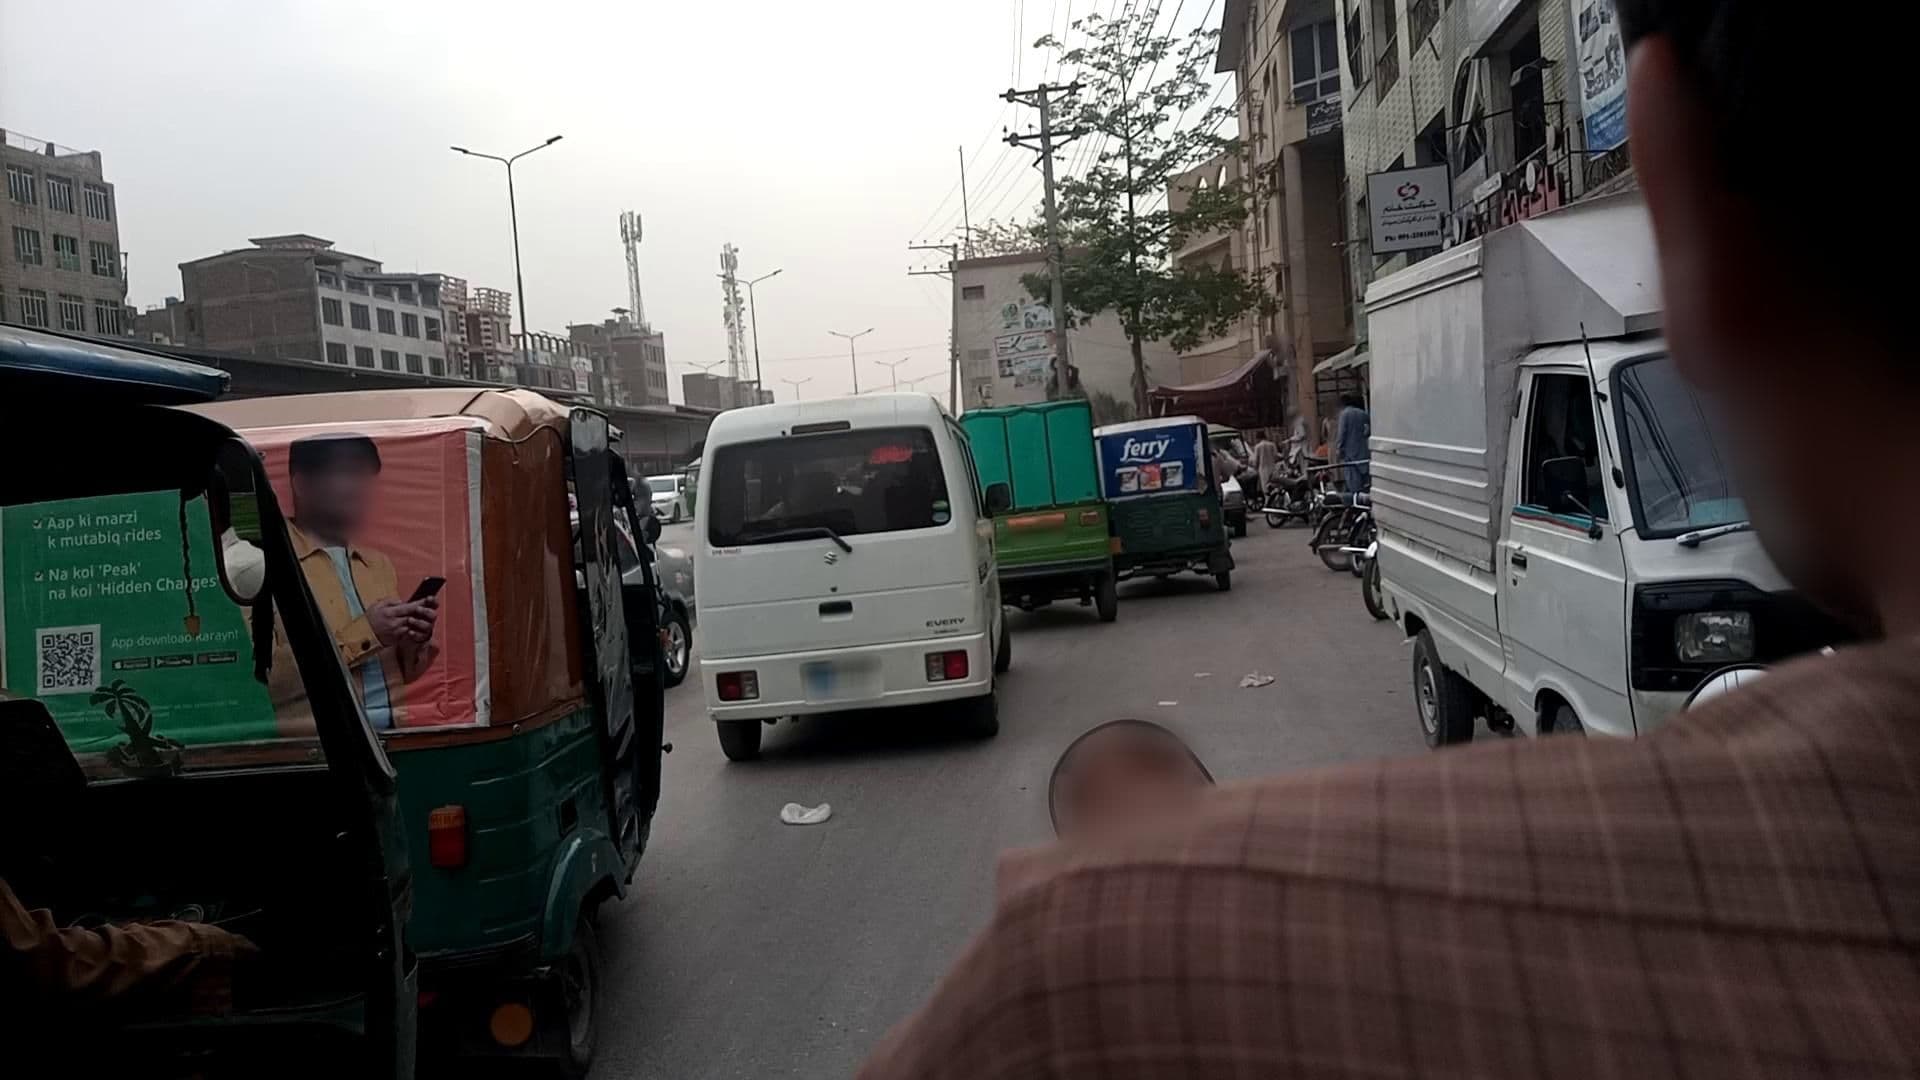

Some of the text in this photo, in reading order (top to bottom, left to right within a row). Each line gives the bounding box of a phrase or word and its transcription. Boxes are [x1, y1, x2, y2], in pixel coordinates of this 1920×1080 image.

[1120, 437, 1169, 462] ferry
[47, 510, 137, 531] Aap ki marzi
[48, 528, 162, 549] k mutabiq rides
[49, 562, 141, 581] Na koi 'Peak'
[49, 588, 66, 600] na
[71, 585, 92, 598] koi
[97, 581, 152, 596] 'Hidden
[926, 617, 965, 627] EVERY
[112, 637, 134, 649] App
